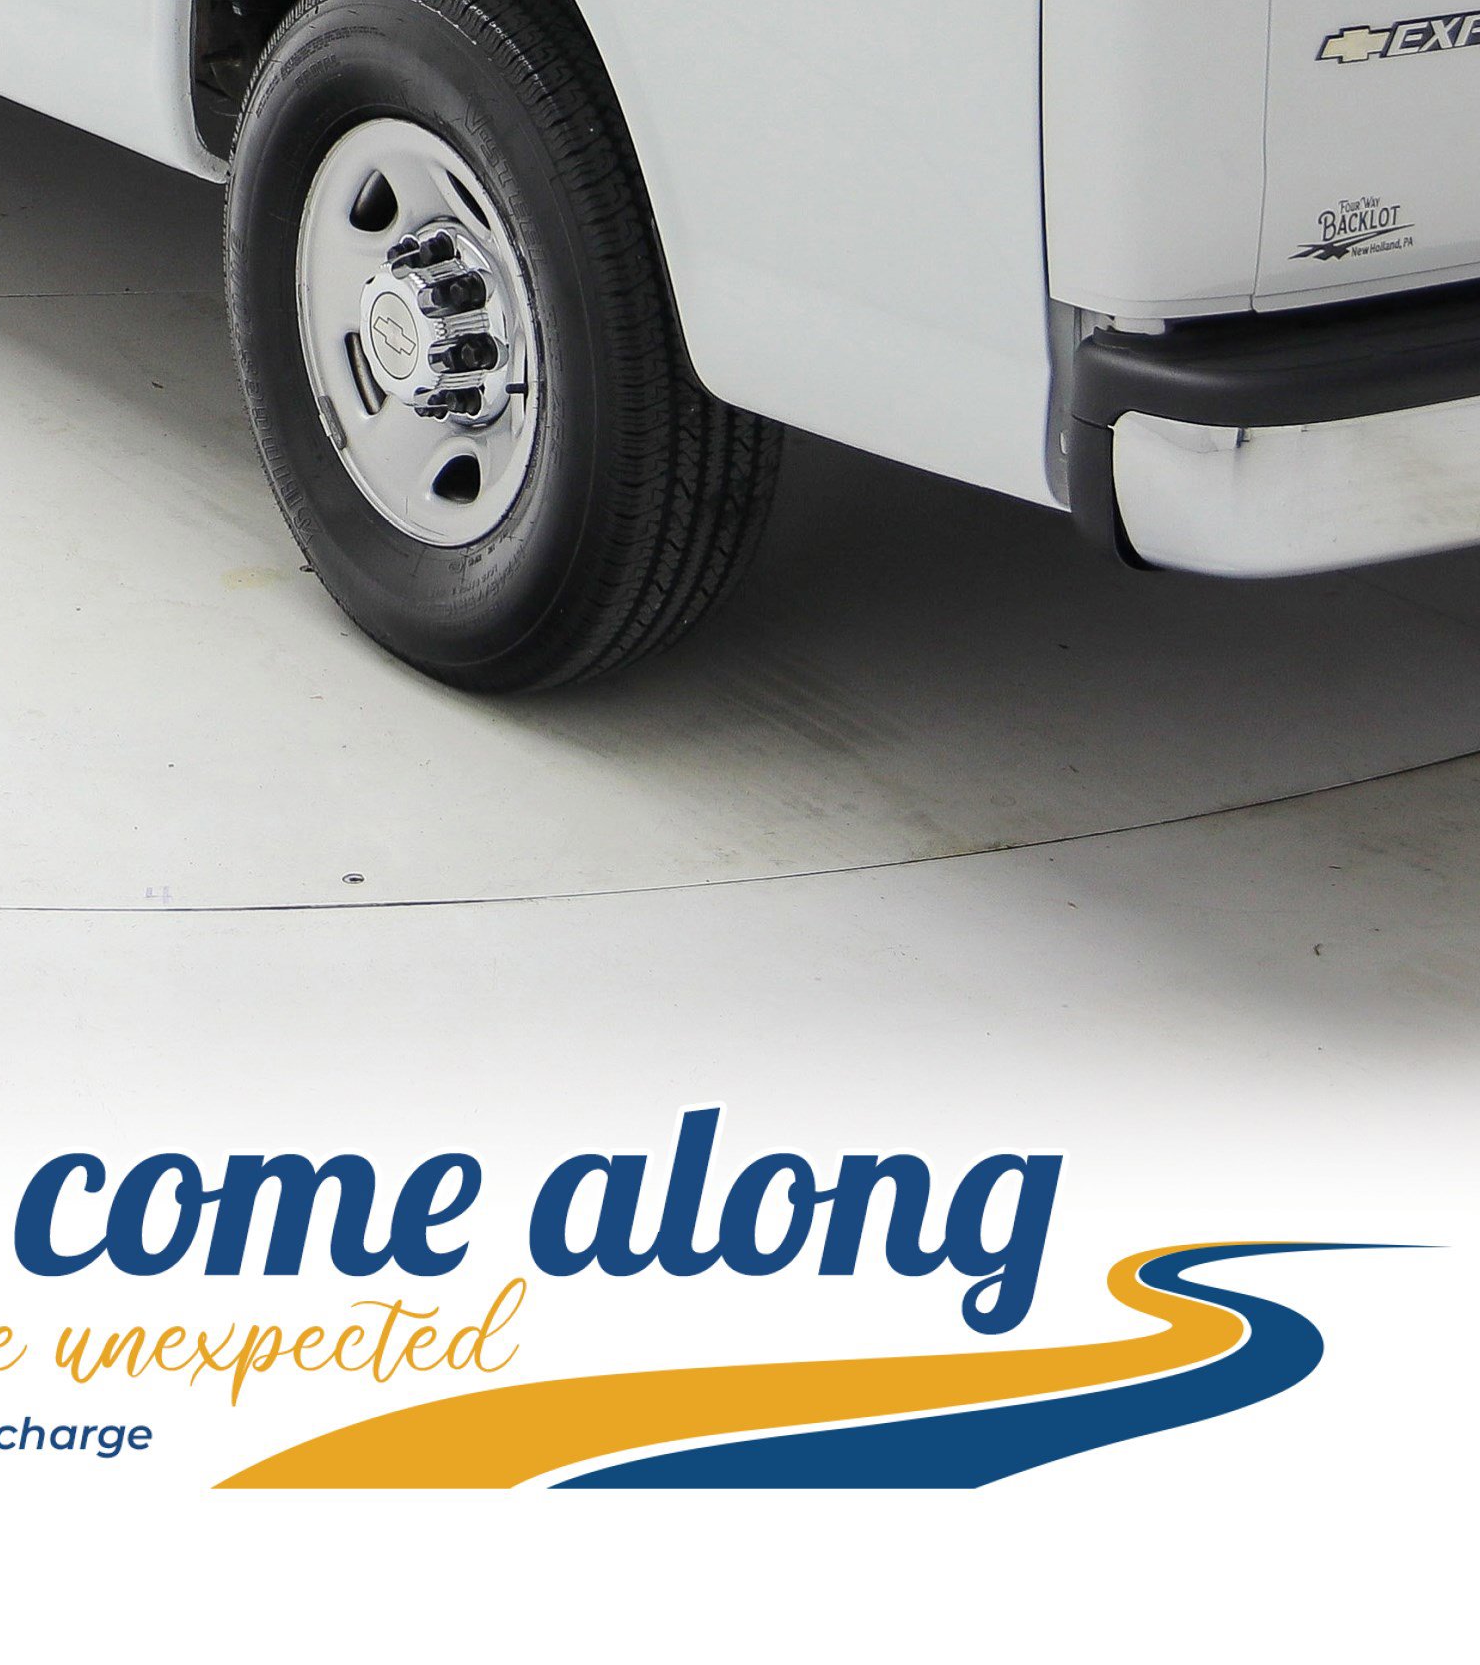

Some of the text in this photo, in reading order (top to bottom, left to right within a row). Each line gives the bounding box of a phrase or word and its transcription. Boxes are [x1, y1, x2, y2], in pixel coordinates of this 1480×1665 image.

[1338, 195, 1381, 215] FOUR WAY
[1317, 205, 1401, 242] BACKLOT
[1351, 236, 1414, 257] New Holland, PA
